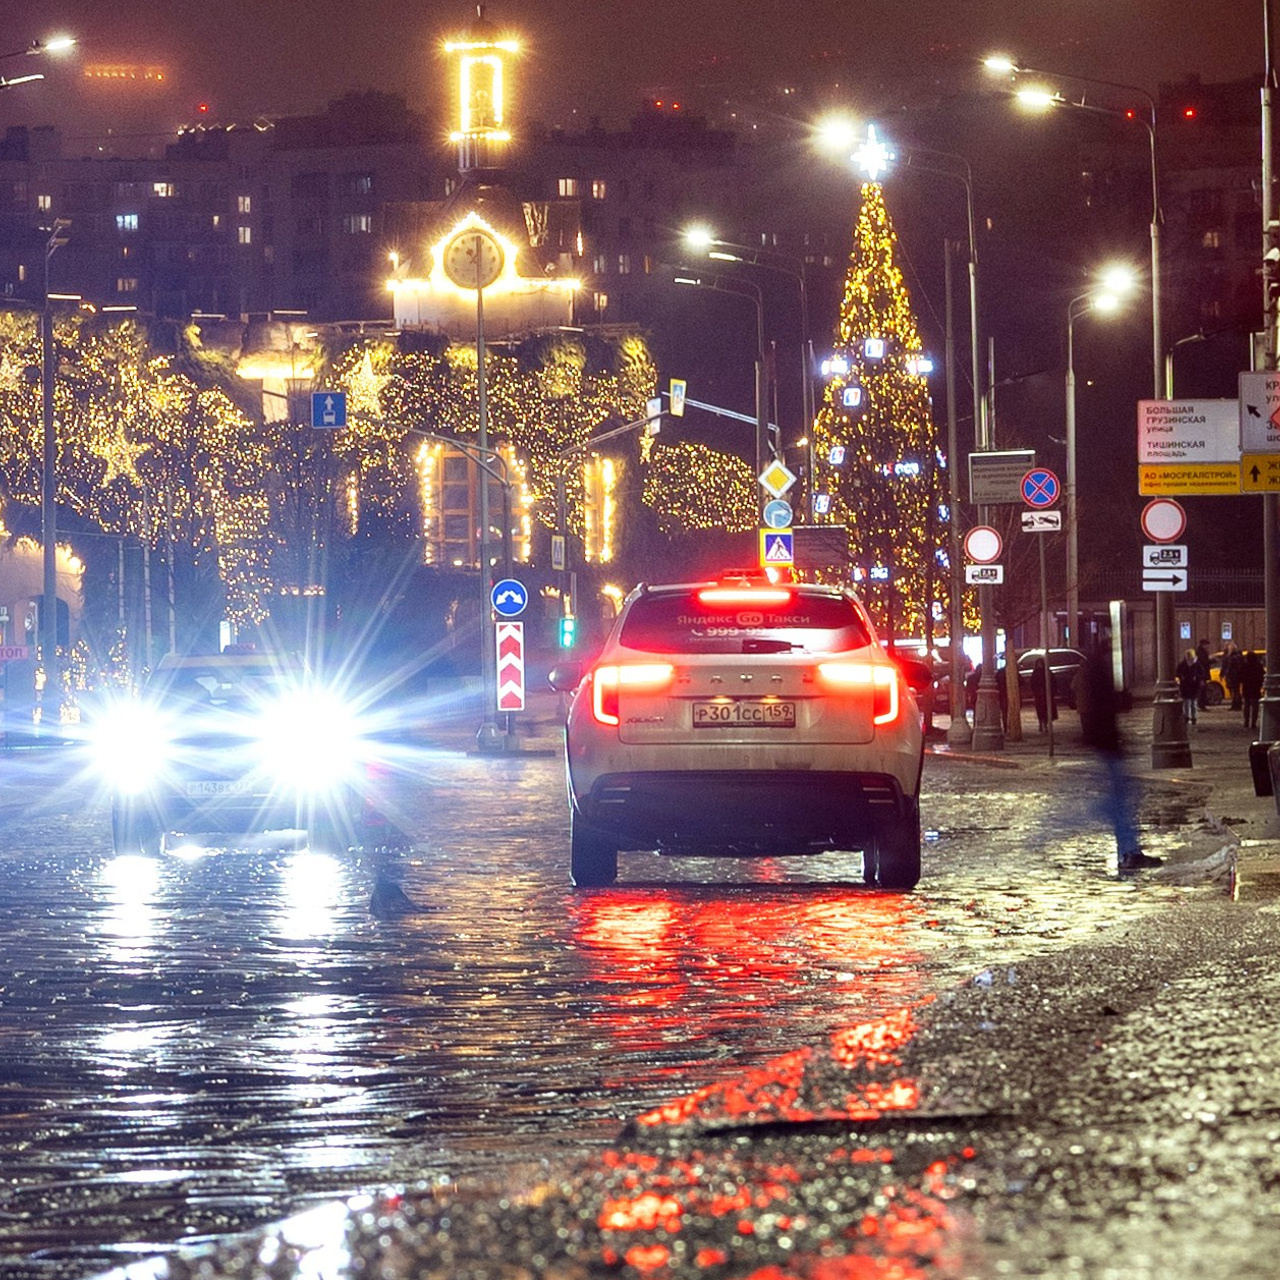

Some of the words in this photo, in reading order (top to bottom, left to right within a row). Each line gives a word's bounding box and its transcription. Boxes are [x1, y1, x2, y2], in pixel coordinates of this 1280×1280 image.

[1146, 406, 1194, 414] БОЛЬШАЯ
[1146, 416, 1206, 424] ГРУЗИНСКАЯ
[1147, 441, 1205, 449] ТИШИНСКАЯ
[677, 614, 733, 625] Яндекс
[739, 613, 761, 624] Go
[766, 613, 811, 623] Такси
